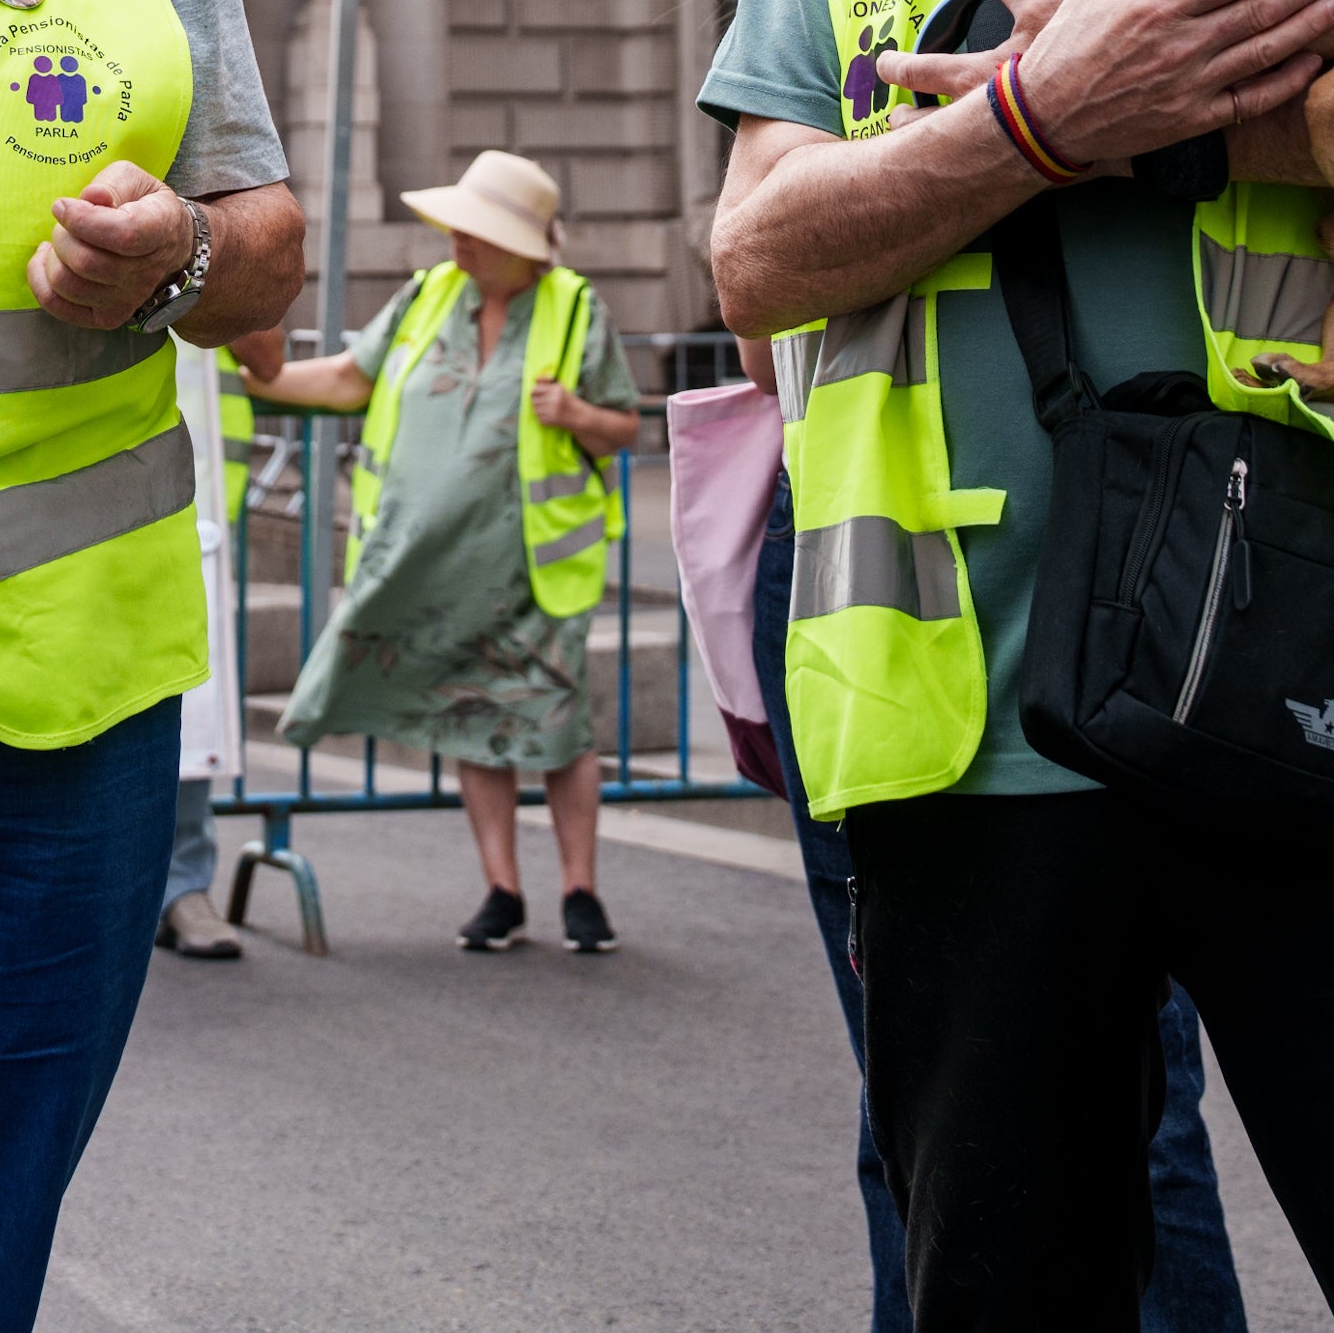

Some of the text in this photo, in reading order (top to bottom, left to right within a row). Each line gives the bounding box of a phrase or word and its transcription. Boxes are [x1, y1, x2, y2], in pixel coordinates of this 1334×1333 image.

[9, 44, 94, 62] PENSIONISTAS
[8, 15, 105, 59] Pensionistas
[106, 60, 123, 76] de
[117, 79, 133, 122] Parla
[35, 126, 79, 139] PARLA
[4, 135, 108, 166] Pensiones Dignas
